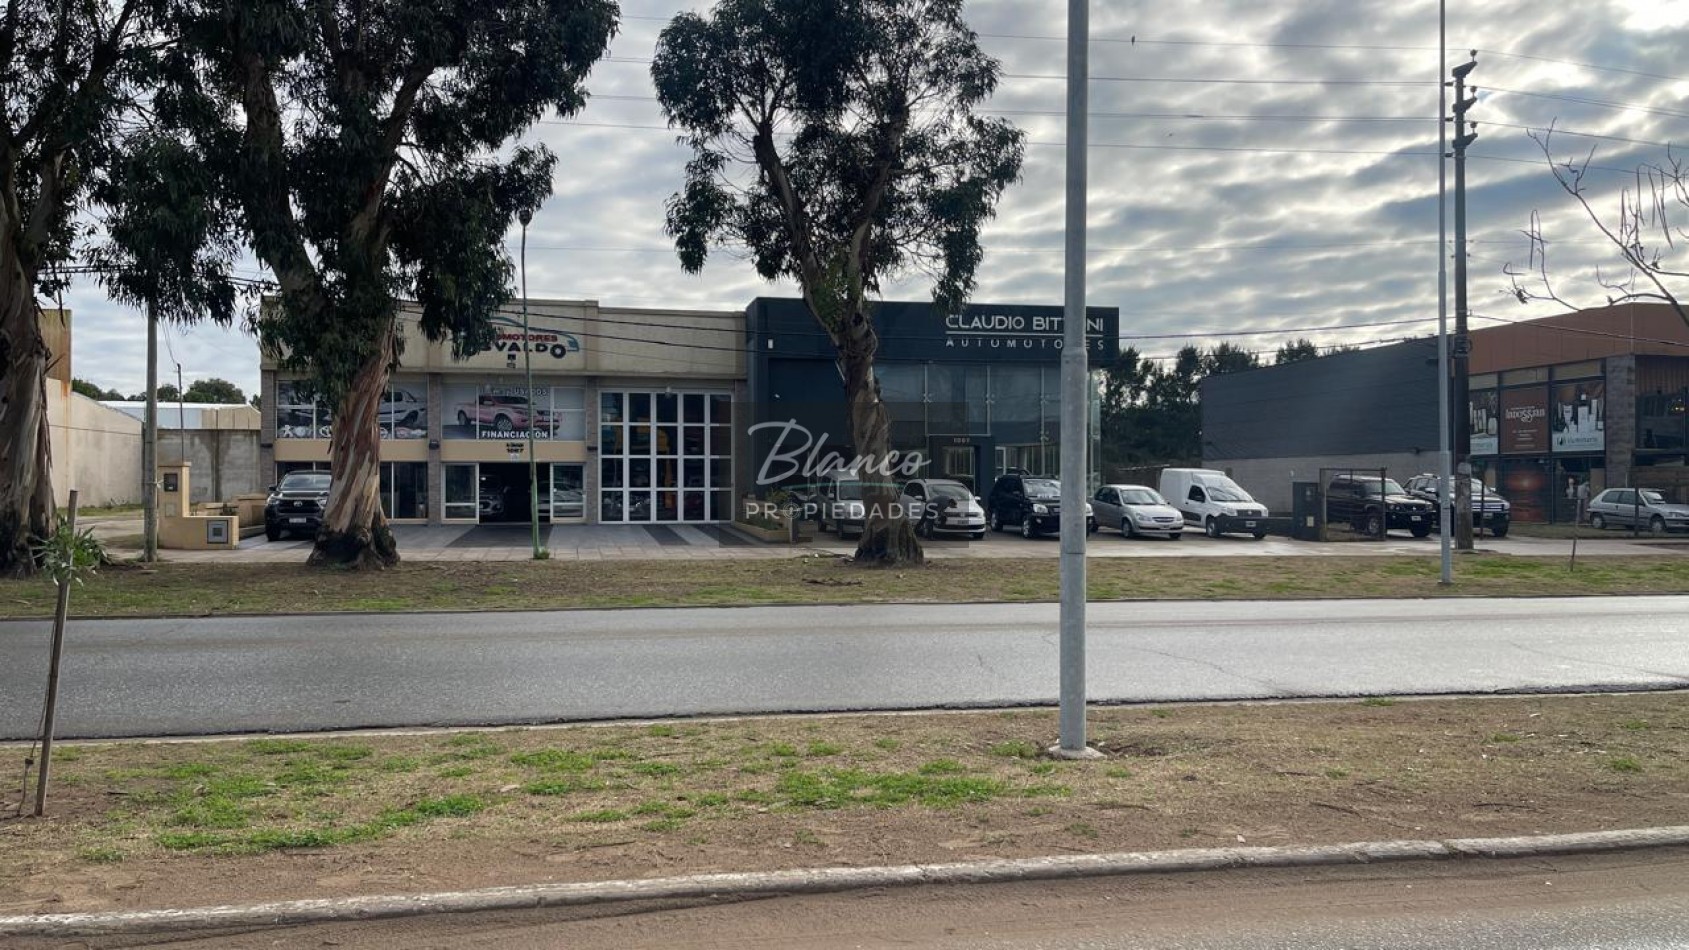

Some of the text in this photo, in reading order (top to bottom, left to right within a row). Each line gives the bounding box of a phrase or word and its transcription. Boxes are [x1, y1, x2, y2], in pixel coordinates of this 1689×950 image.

[946, 314, 1104, 331] CLAUDIO BITNI
[946, 338, 1104, 350] AUTOMOTOES
[481, 430, 549, 439] FINANCIACON
